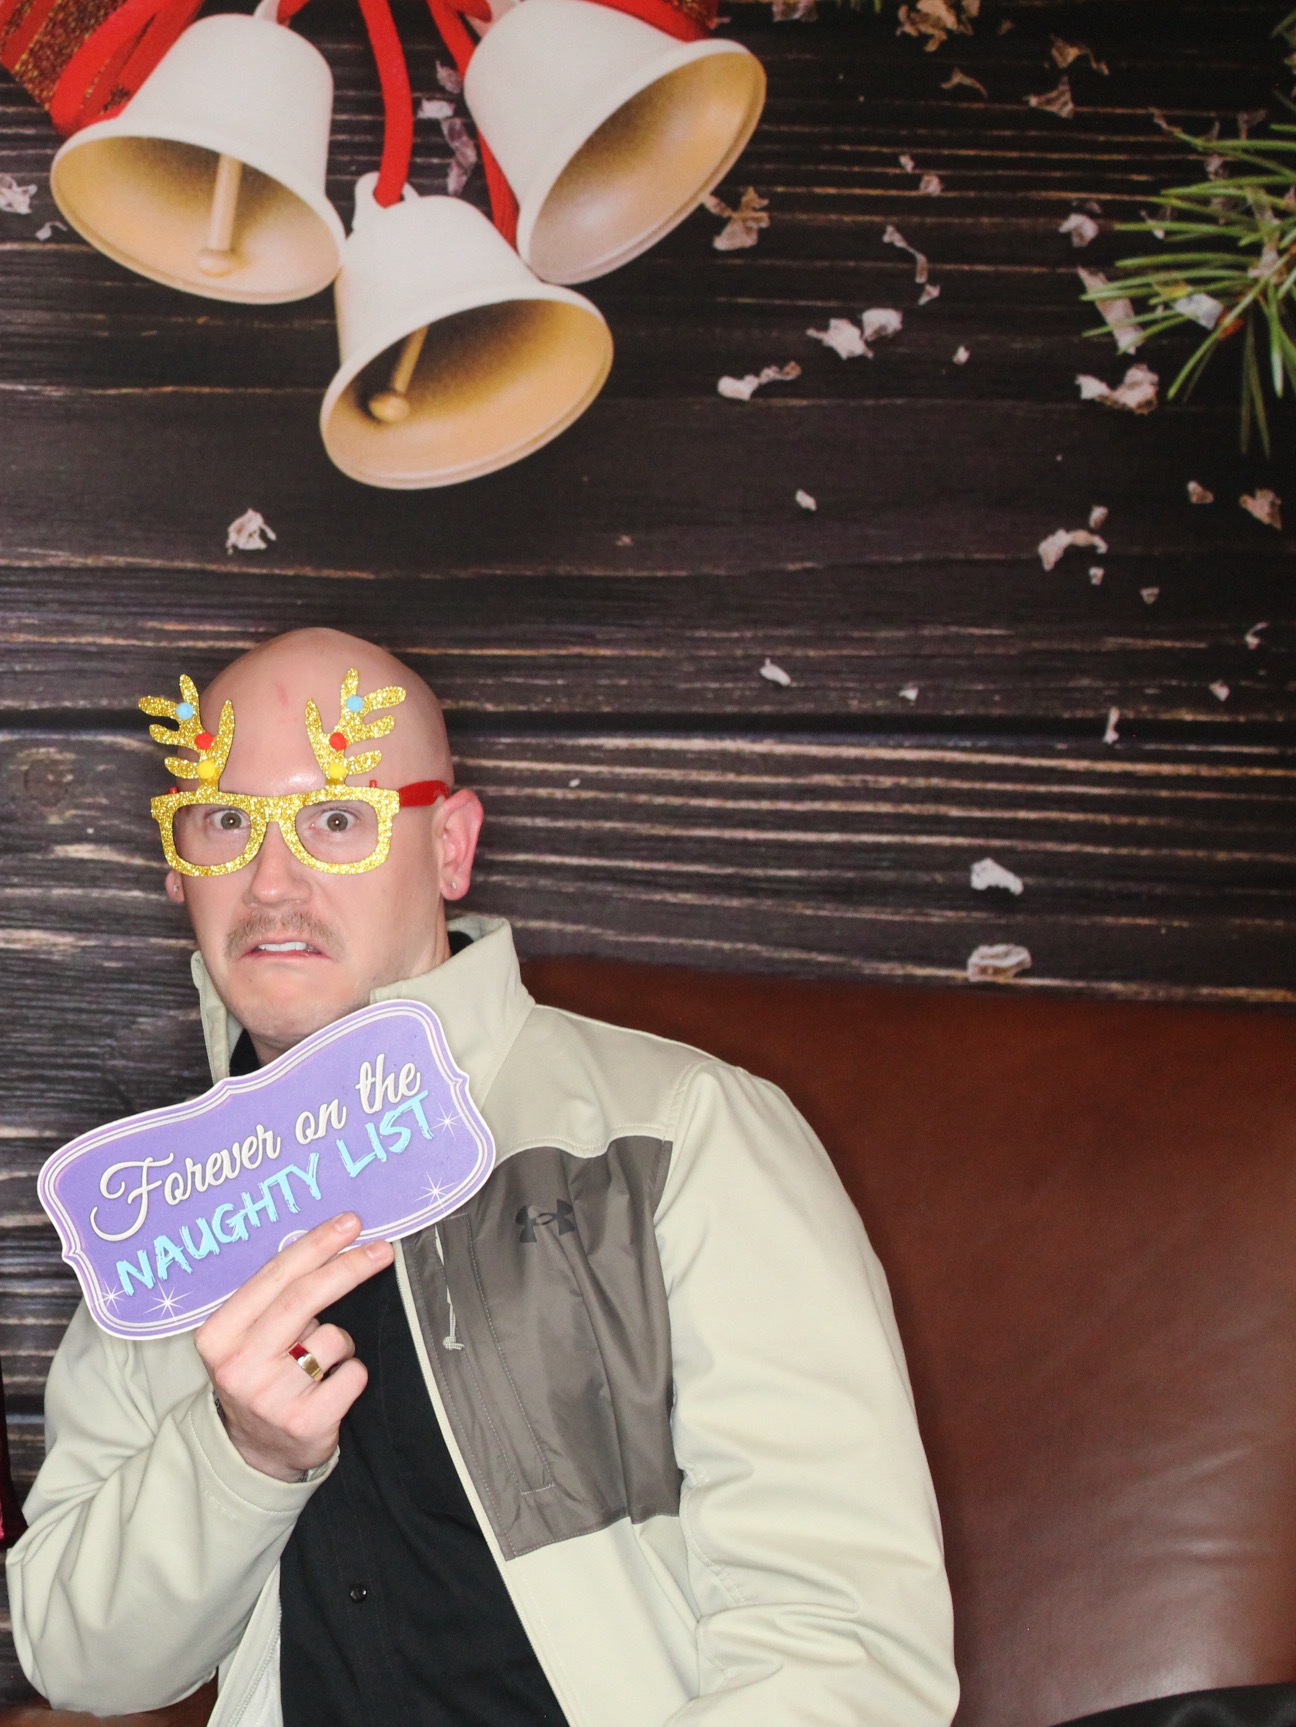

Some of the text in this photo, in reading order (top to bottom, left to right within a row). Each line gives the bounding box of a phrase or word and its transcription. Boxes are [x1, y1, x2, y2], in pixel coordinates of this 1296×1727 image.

[90, 1053, 422, 1242] Forever on the
[115, 1090, 435, 1297] NAUGHTY LIST
